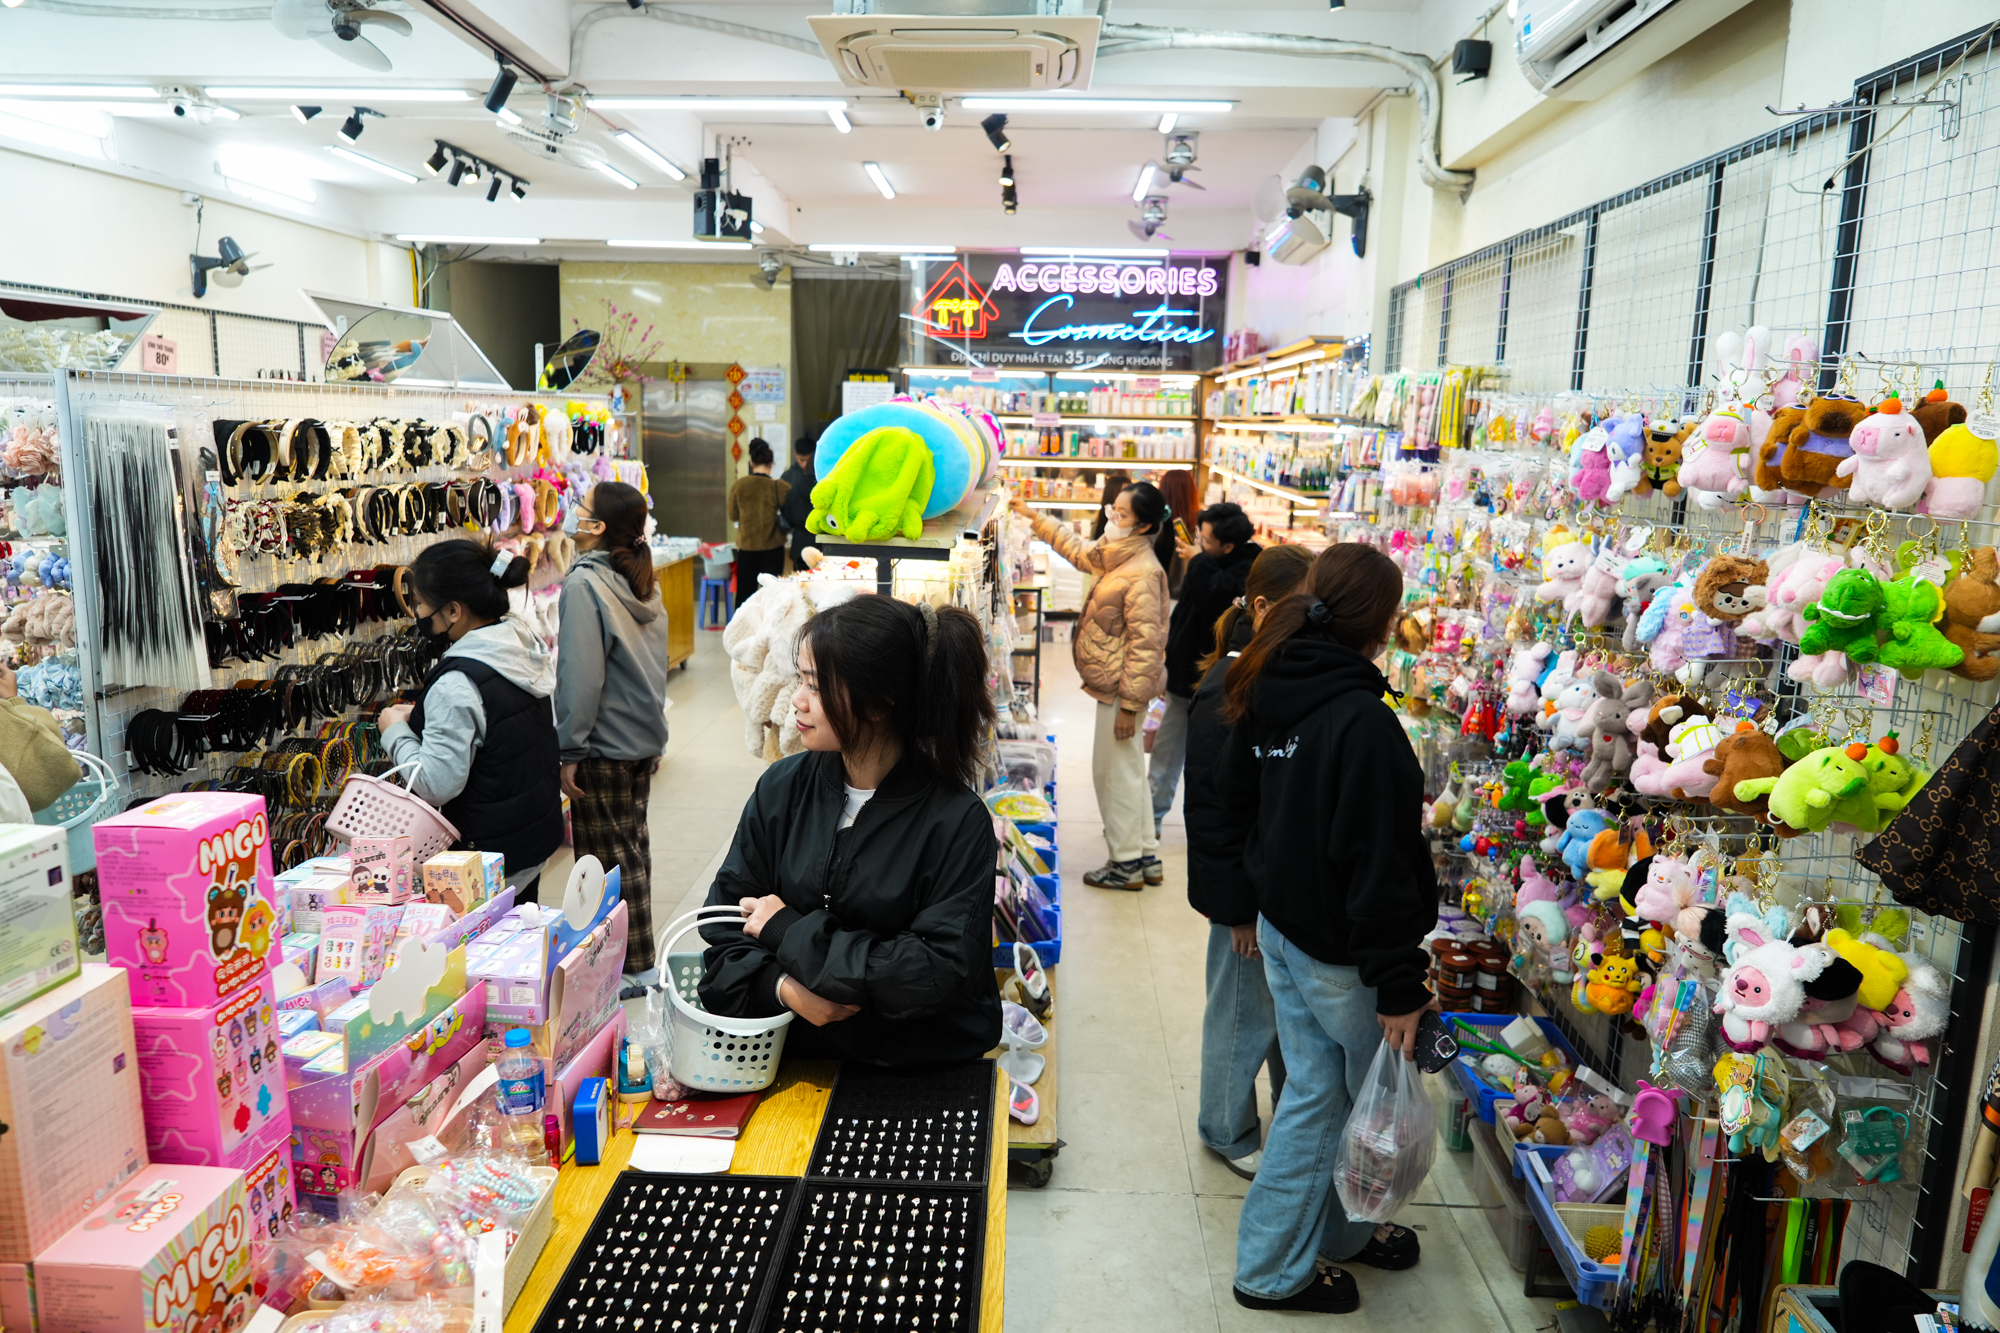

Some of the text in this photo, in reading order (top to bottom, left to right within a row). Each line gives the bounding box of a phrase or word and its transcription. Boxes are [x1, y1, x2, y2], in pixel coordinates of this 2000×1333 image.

[992, 263, 1218, 296] ACCESSORIES
[1022, 293, 1216, 347] Cosmetics
[992, 354, 1014, 363] DUY
[1064, 351, 1085, 364] 35
[1125, 356, 1174, 367] KHOANG
[199, 812, 267, 875] MIGO
[285, 994, 311, 1010] MIGO
[127, 1193, 184, 1233] MIGO
[153, 1203, 243, 1328] MIGO
